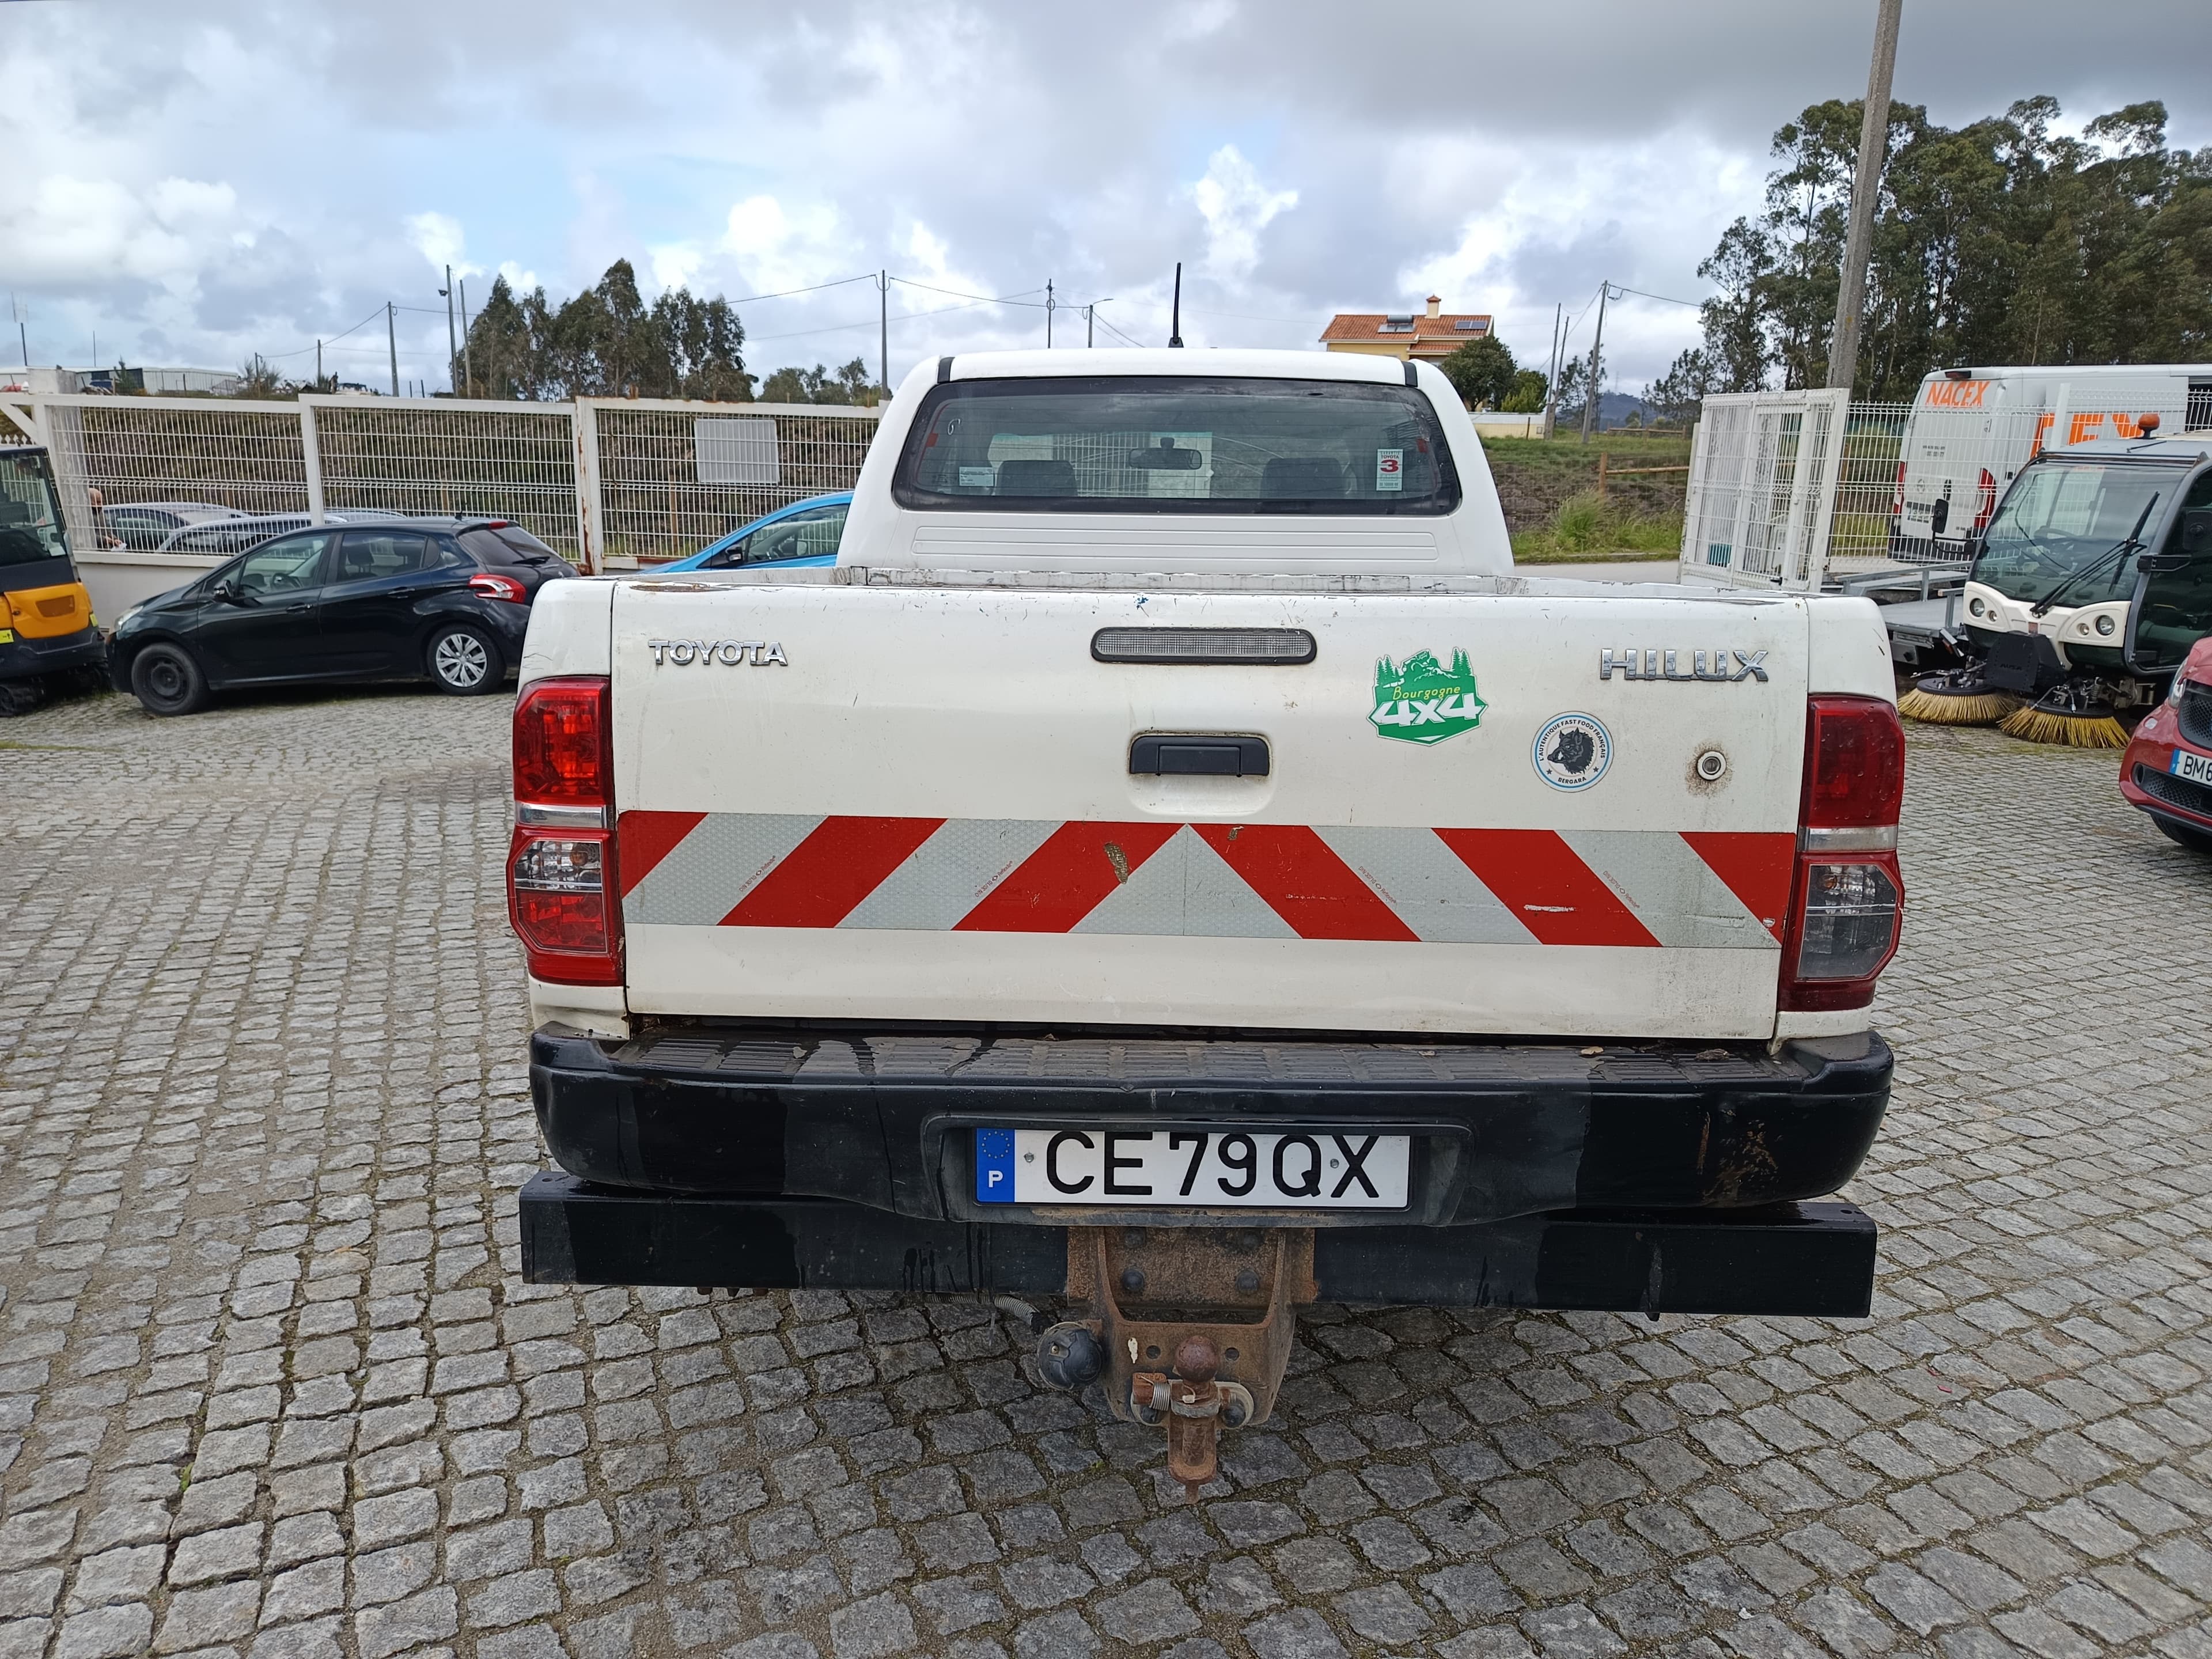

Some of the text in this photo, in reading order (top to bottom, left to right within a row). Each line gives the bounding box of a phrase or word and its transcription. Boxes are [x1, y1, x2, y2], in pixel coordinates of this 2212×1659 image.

[1925, 380, 1990, 407] NACEX
[1380, 459, 1399, 472] 3
[649, 640, 788, 666] TOYOTA
[1600, 649, 1768, 681] HILUX
[1393, 686, 1461, 700] Bourgogne
[1578, 720, 1594, 730] FOOD
[1593, 729, 1605, 759] FRANÇAIS
[988, 1170, 1003, 1188] P
